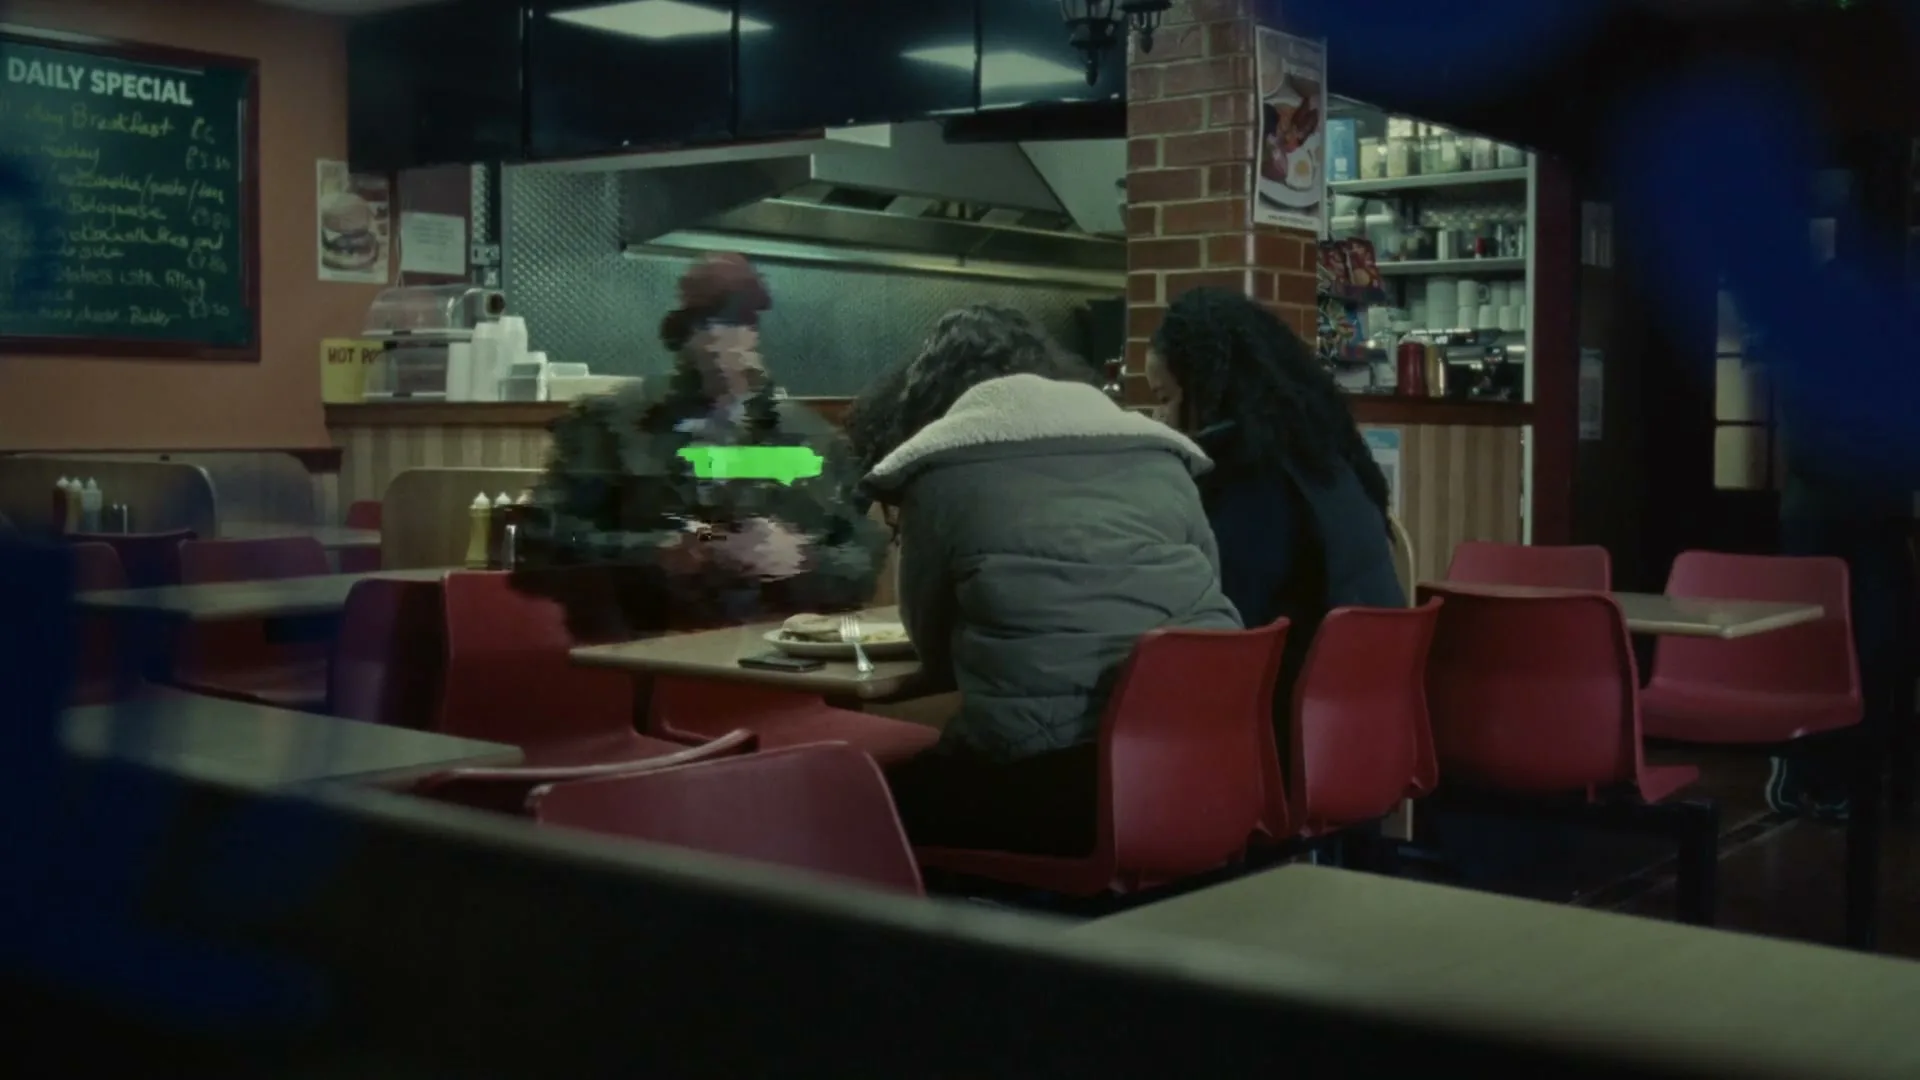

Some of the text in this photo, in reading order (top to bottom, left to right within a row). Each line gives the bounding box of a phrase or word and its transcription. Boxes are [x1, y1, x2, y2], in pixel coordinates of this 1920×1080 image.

[7, 56, 195, 108] DAILY SPECIAL
[71, 102, 176, 138] Breakfast
[328, 347, 355, 364] HOT
